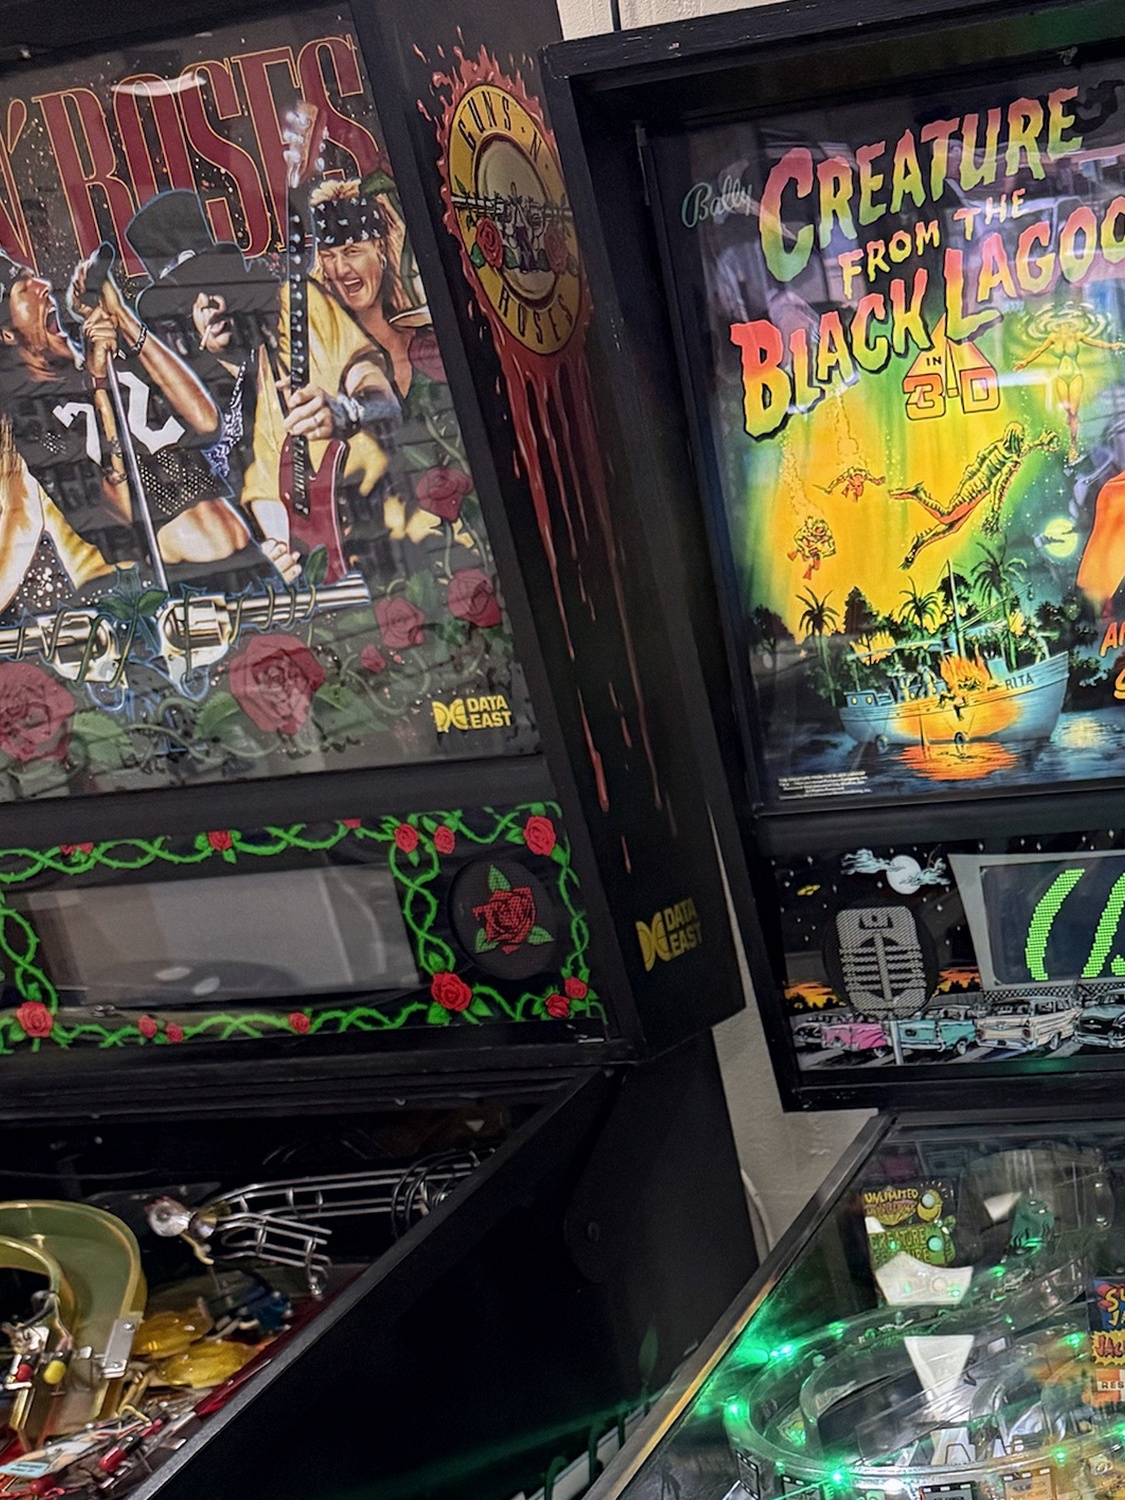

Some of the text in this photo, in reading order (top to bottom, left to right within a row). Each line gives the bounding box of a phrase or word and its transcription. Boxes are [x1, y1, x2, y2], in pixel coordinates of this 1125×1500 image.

[457, 91, 512, 152] GUNS
[33, 33, 384, 281] ROSES
[682, 176, 756, 228] Bally
[758, 86, 1085, 283] CREATURE
[839, 189, 1027, 298] FROM THE
[730, 268, 932, 440] BLACK
[925, 355, 942, 368] IN
[902, 367, 999, 421] 3-D
[1005, 673, 1034, 691] RITA
[466, 695, 508, 712] DATA
[470, 711, 511, 729] EAST
[663, 898, 698, 931] DATA
[669, 921, 702, 957] EAST
[863, 1188, 919, 1203] UNLIMITED
[870, 1227, 927, 1249] CREATURE
